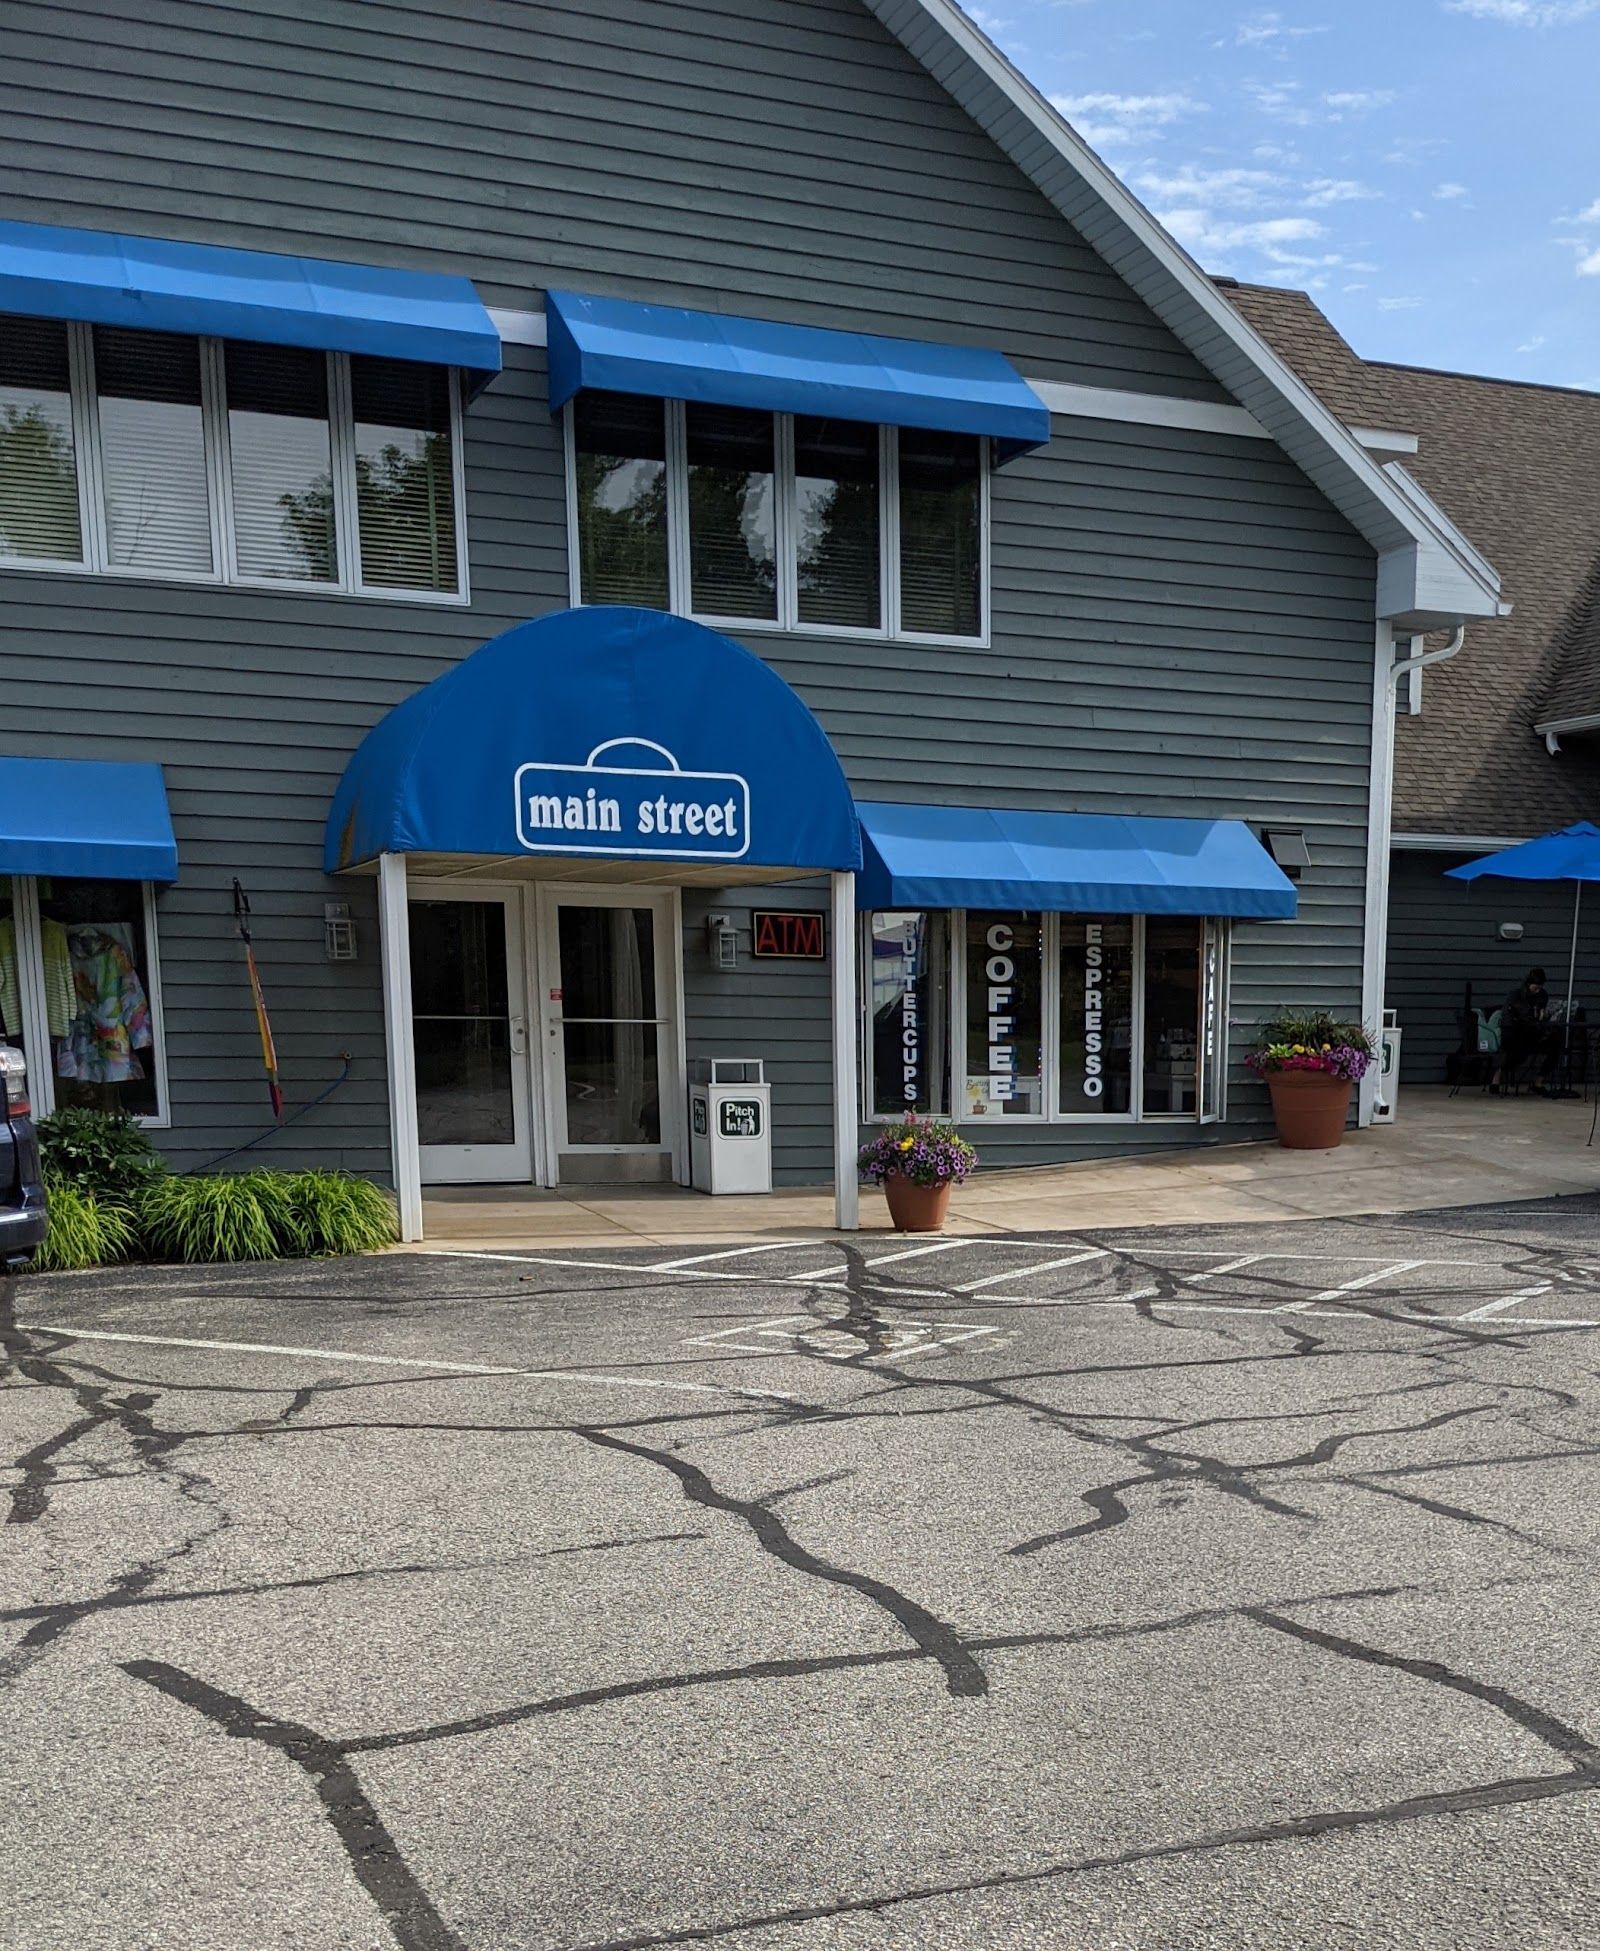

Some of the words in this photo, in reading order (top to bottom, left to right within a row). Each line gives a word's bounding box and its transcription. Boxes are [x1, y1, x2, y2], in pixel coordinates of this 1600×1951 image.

[528, 787, 622, 832] main
[637, 794, 738, 837] street
[757, 914, 821, 956] ATM
[902, 920, 917, 1101] BUTTERCUPS
[985, 924, 1014, 1100] COFFEE
[1083, 924, 1103, 1098] ESPRESSO
[1207, 947, 1215, 1056] CAFE
[725, 1102, 755, 1117] Pitch
[725, 1117, 742, 1132] In!
